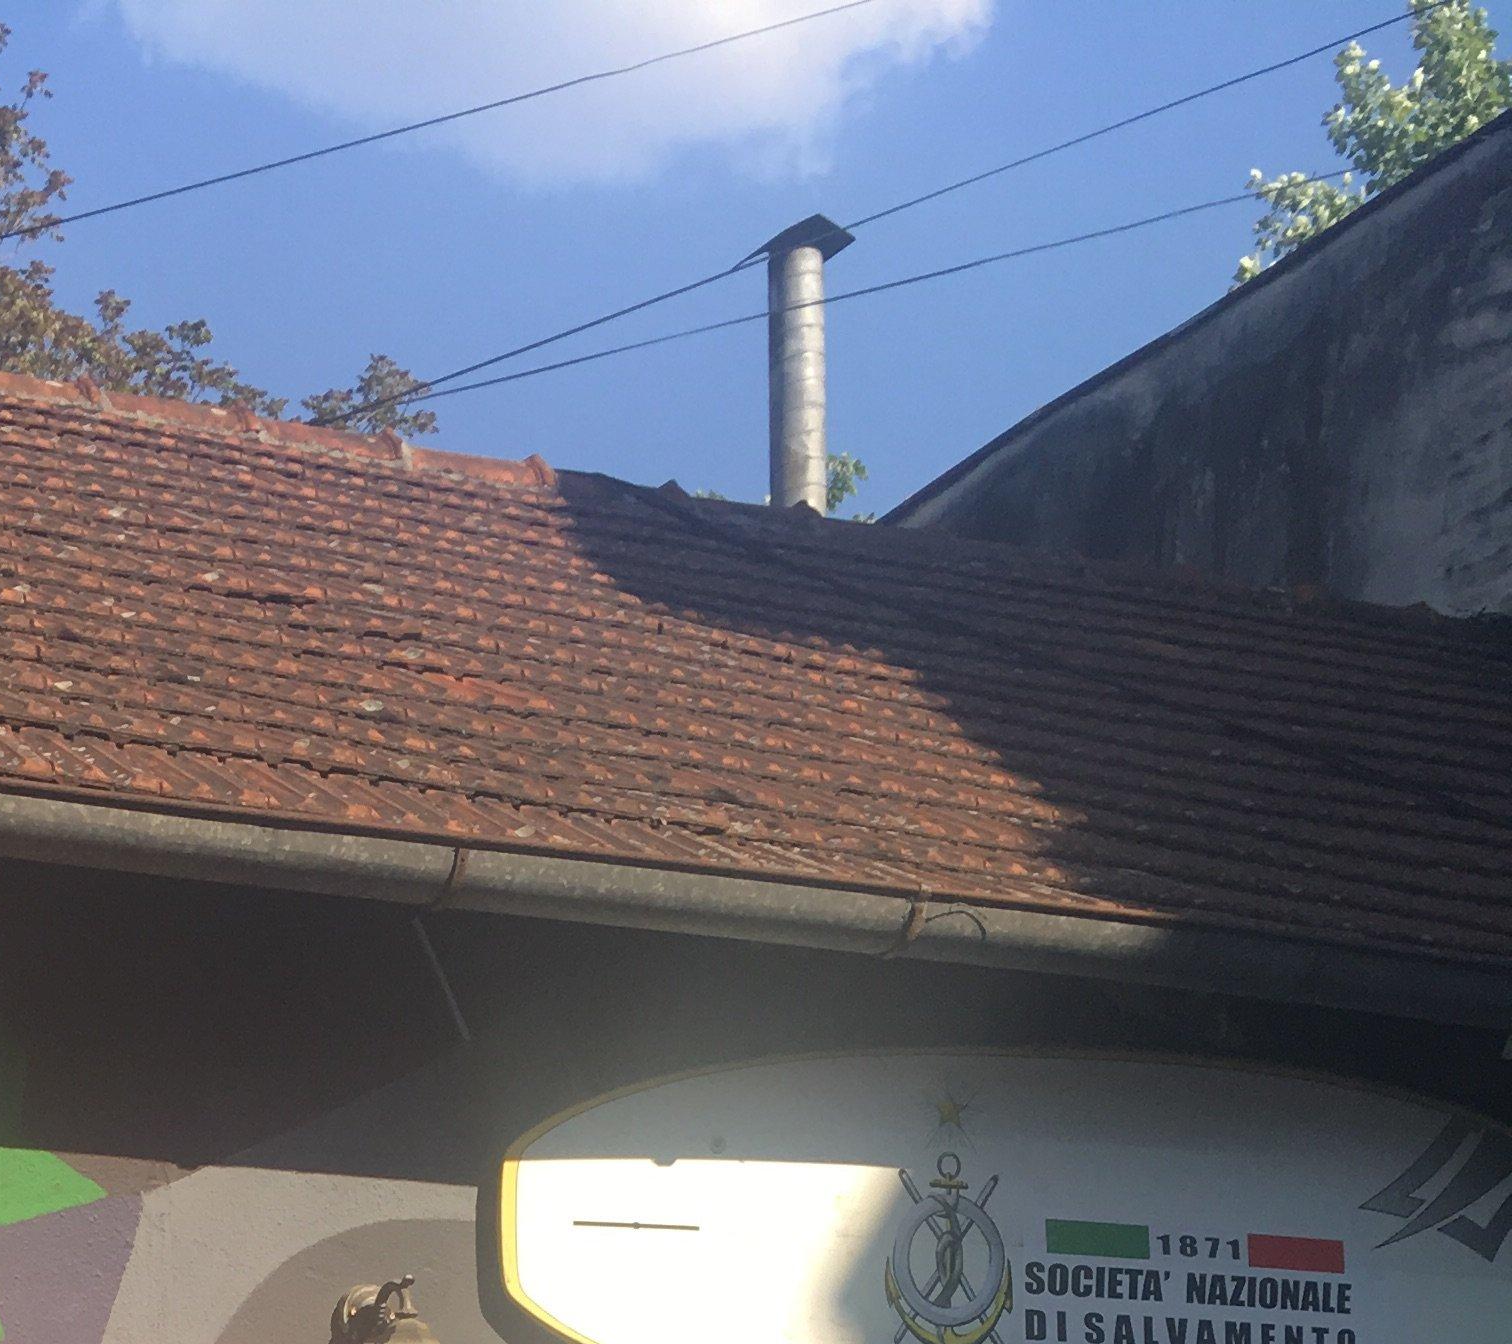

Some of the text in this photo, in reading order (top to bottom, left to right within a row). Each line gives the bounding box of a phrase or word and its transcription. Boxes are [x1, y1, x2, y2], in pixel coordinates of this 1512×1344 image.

[1156, 1233, 1241, 1260] 1871
[1024, 1261, 1353, 1315] SOCIETA' NAZIONALE
[1024, 1309, 1068, 1342] DI
